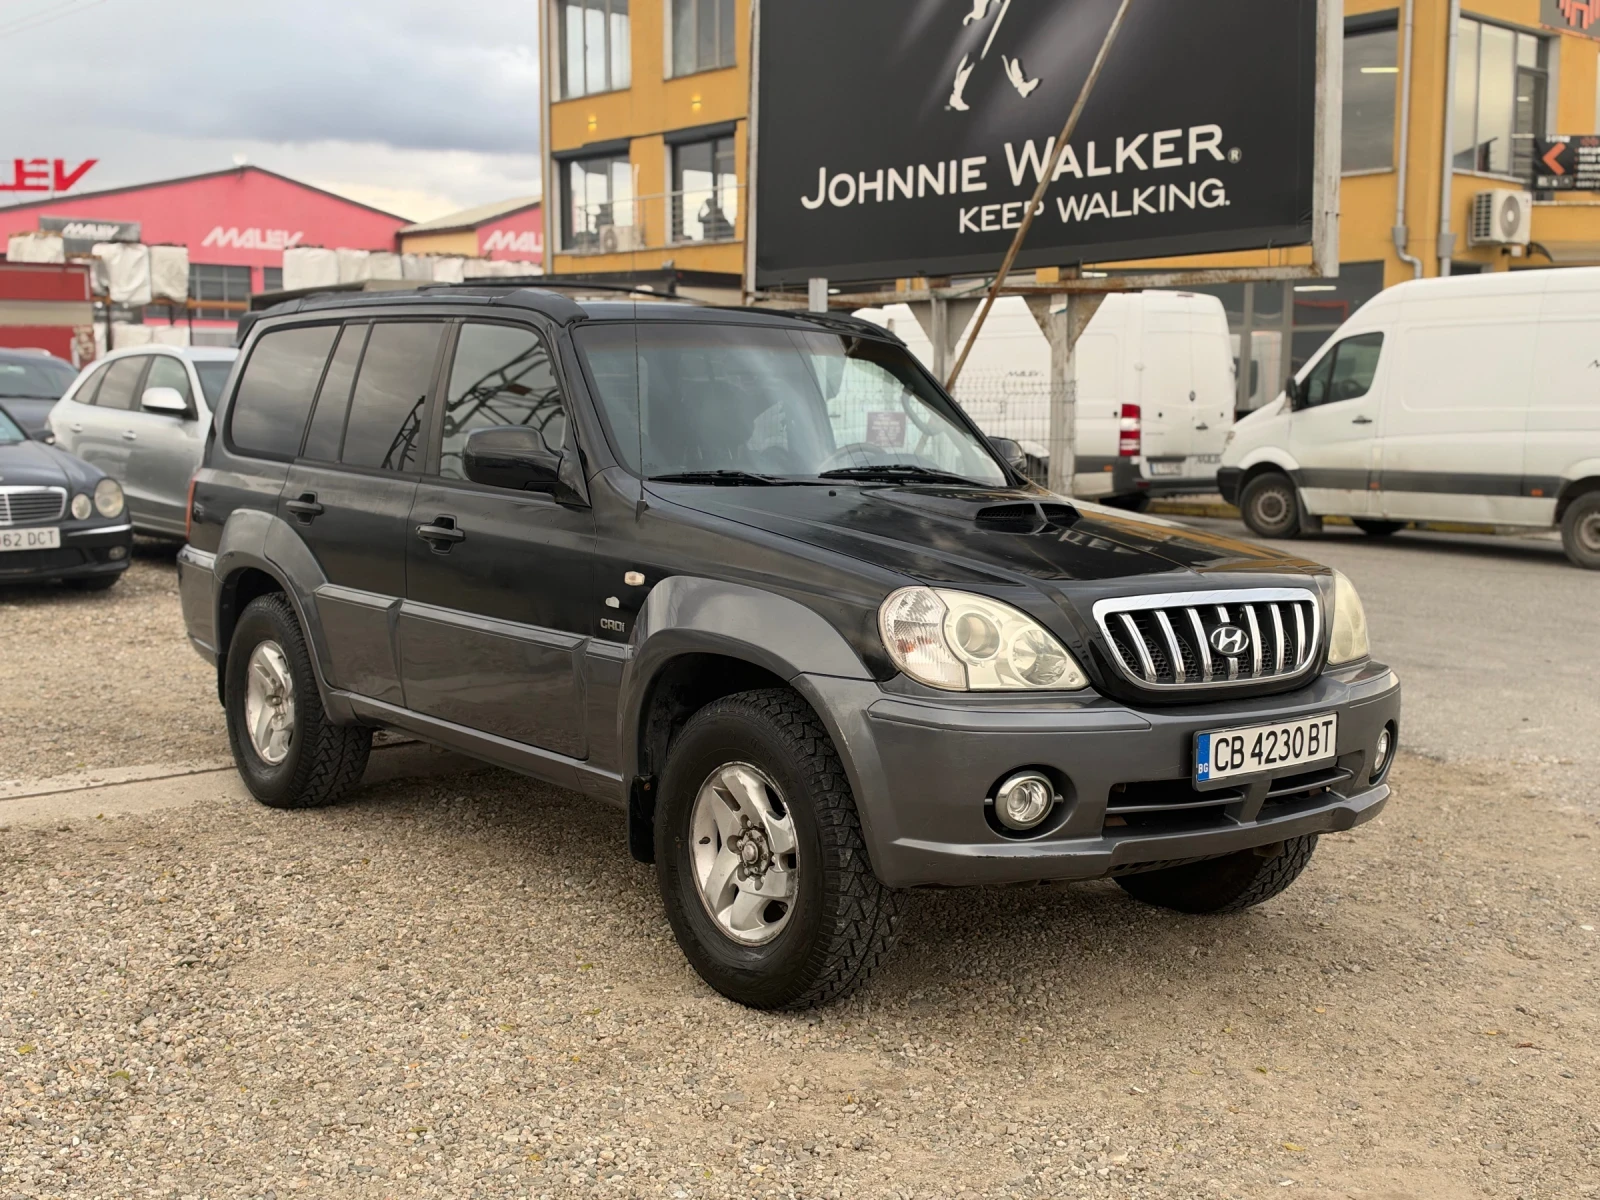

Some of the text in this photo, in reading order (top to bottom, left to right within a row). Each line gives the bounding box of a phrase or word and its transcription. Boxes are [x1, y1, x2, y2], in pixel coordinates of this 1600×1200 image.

[801, 156, 987, 210] JOHNNIE
[200, 226, 304, 250] MALEV
[28, 530, 55, 546] DCT
[1215, 720, 1333, 771] CB 4230 BT
[1198, 763, 1209, 774] BG
